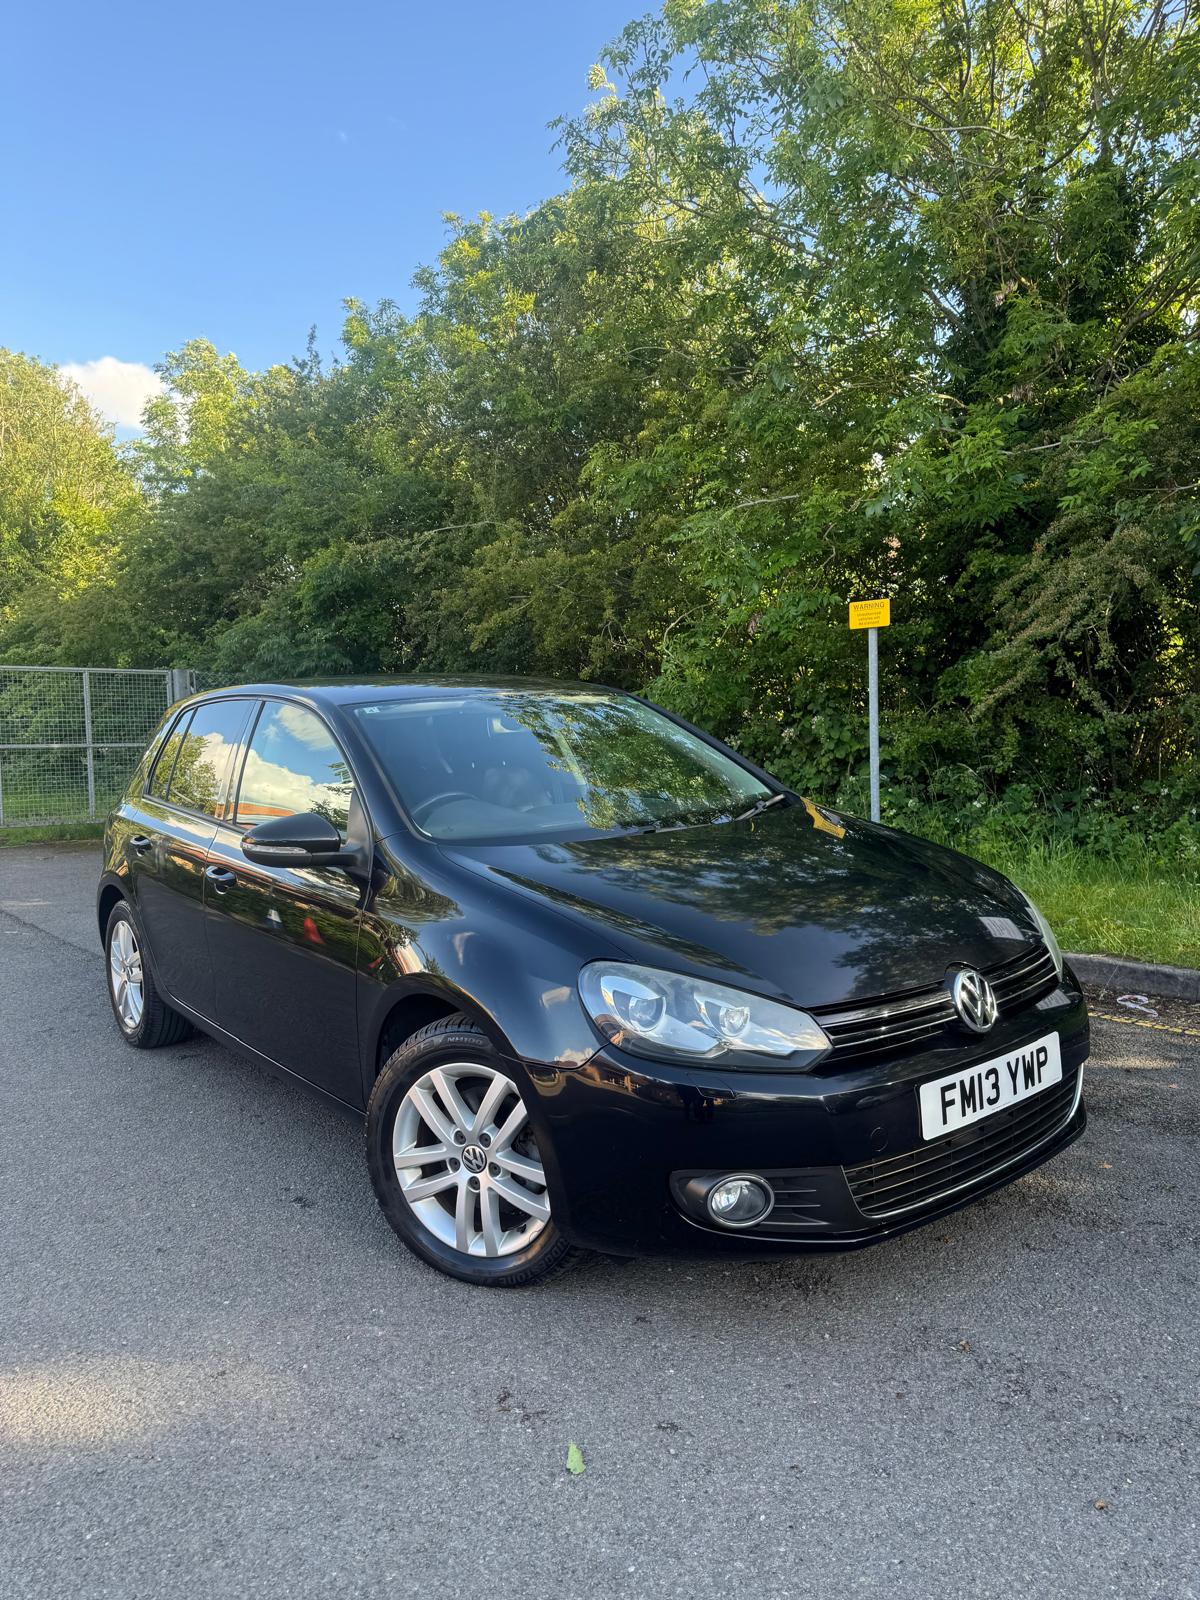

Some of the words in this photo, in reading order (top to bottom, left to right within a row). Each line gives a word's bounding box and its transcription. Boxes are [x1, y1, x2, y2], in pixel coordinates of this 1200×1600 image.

[853, 602, 884, 610] WARNING
[940, 1067, 1000, 1125] FM13
[1006, 1045, 1048, 1095] YWP
